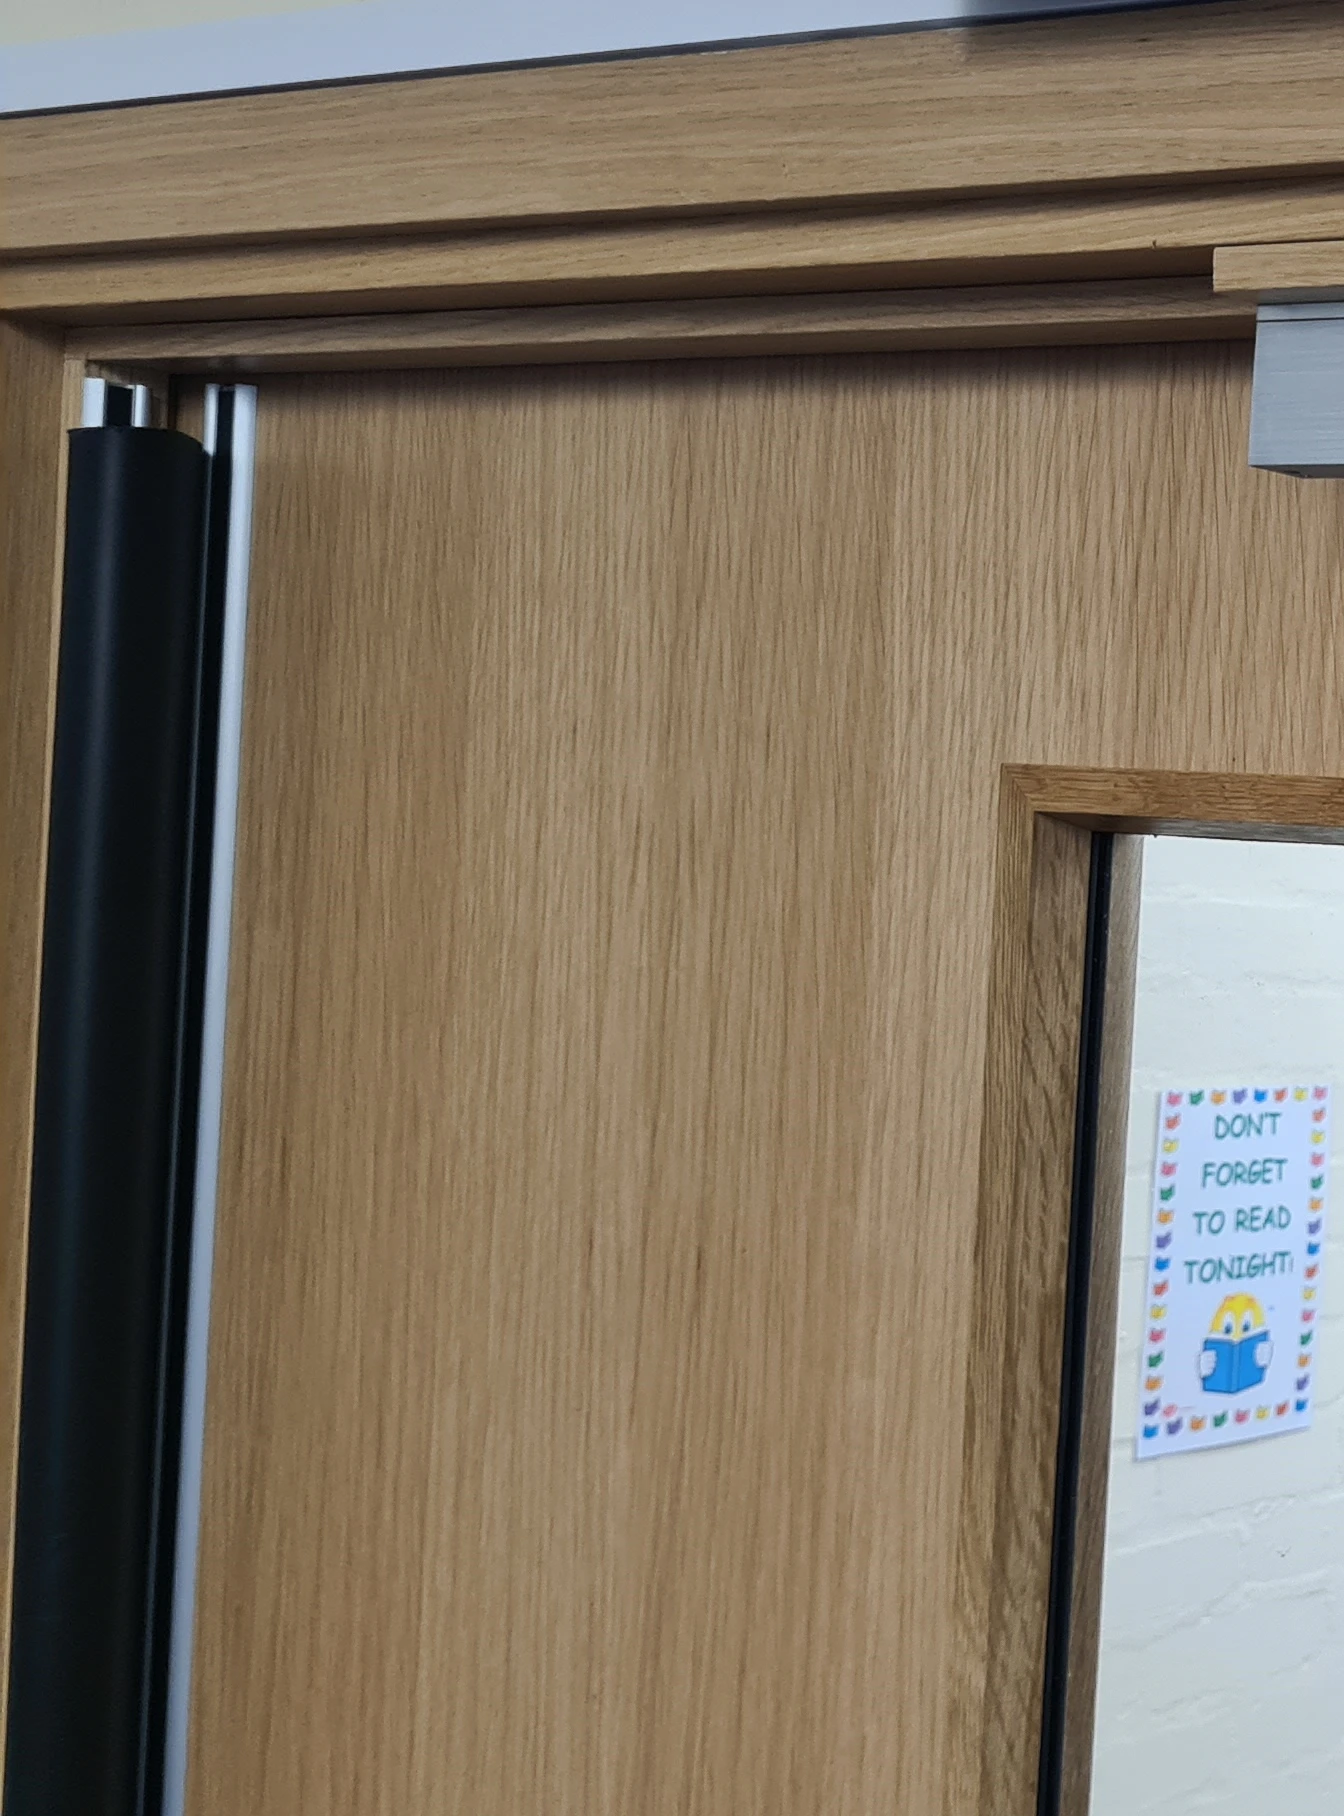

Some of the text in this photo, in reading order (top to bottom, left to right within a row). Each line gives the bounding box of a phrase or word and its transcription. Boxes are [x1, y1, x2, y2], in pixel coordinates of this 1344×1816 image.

[1214, 1111, 1281, 1140] DON'T
[1202, 1158, 1287, 1188] FORGET
[1193, 1205, 1291, 1235] TO READ
